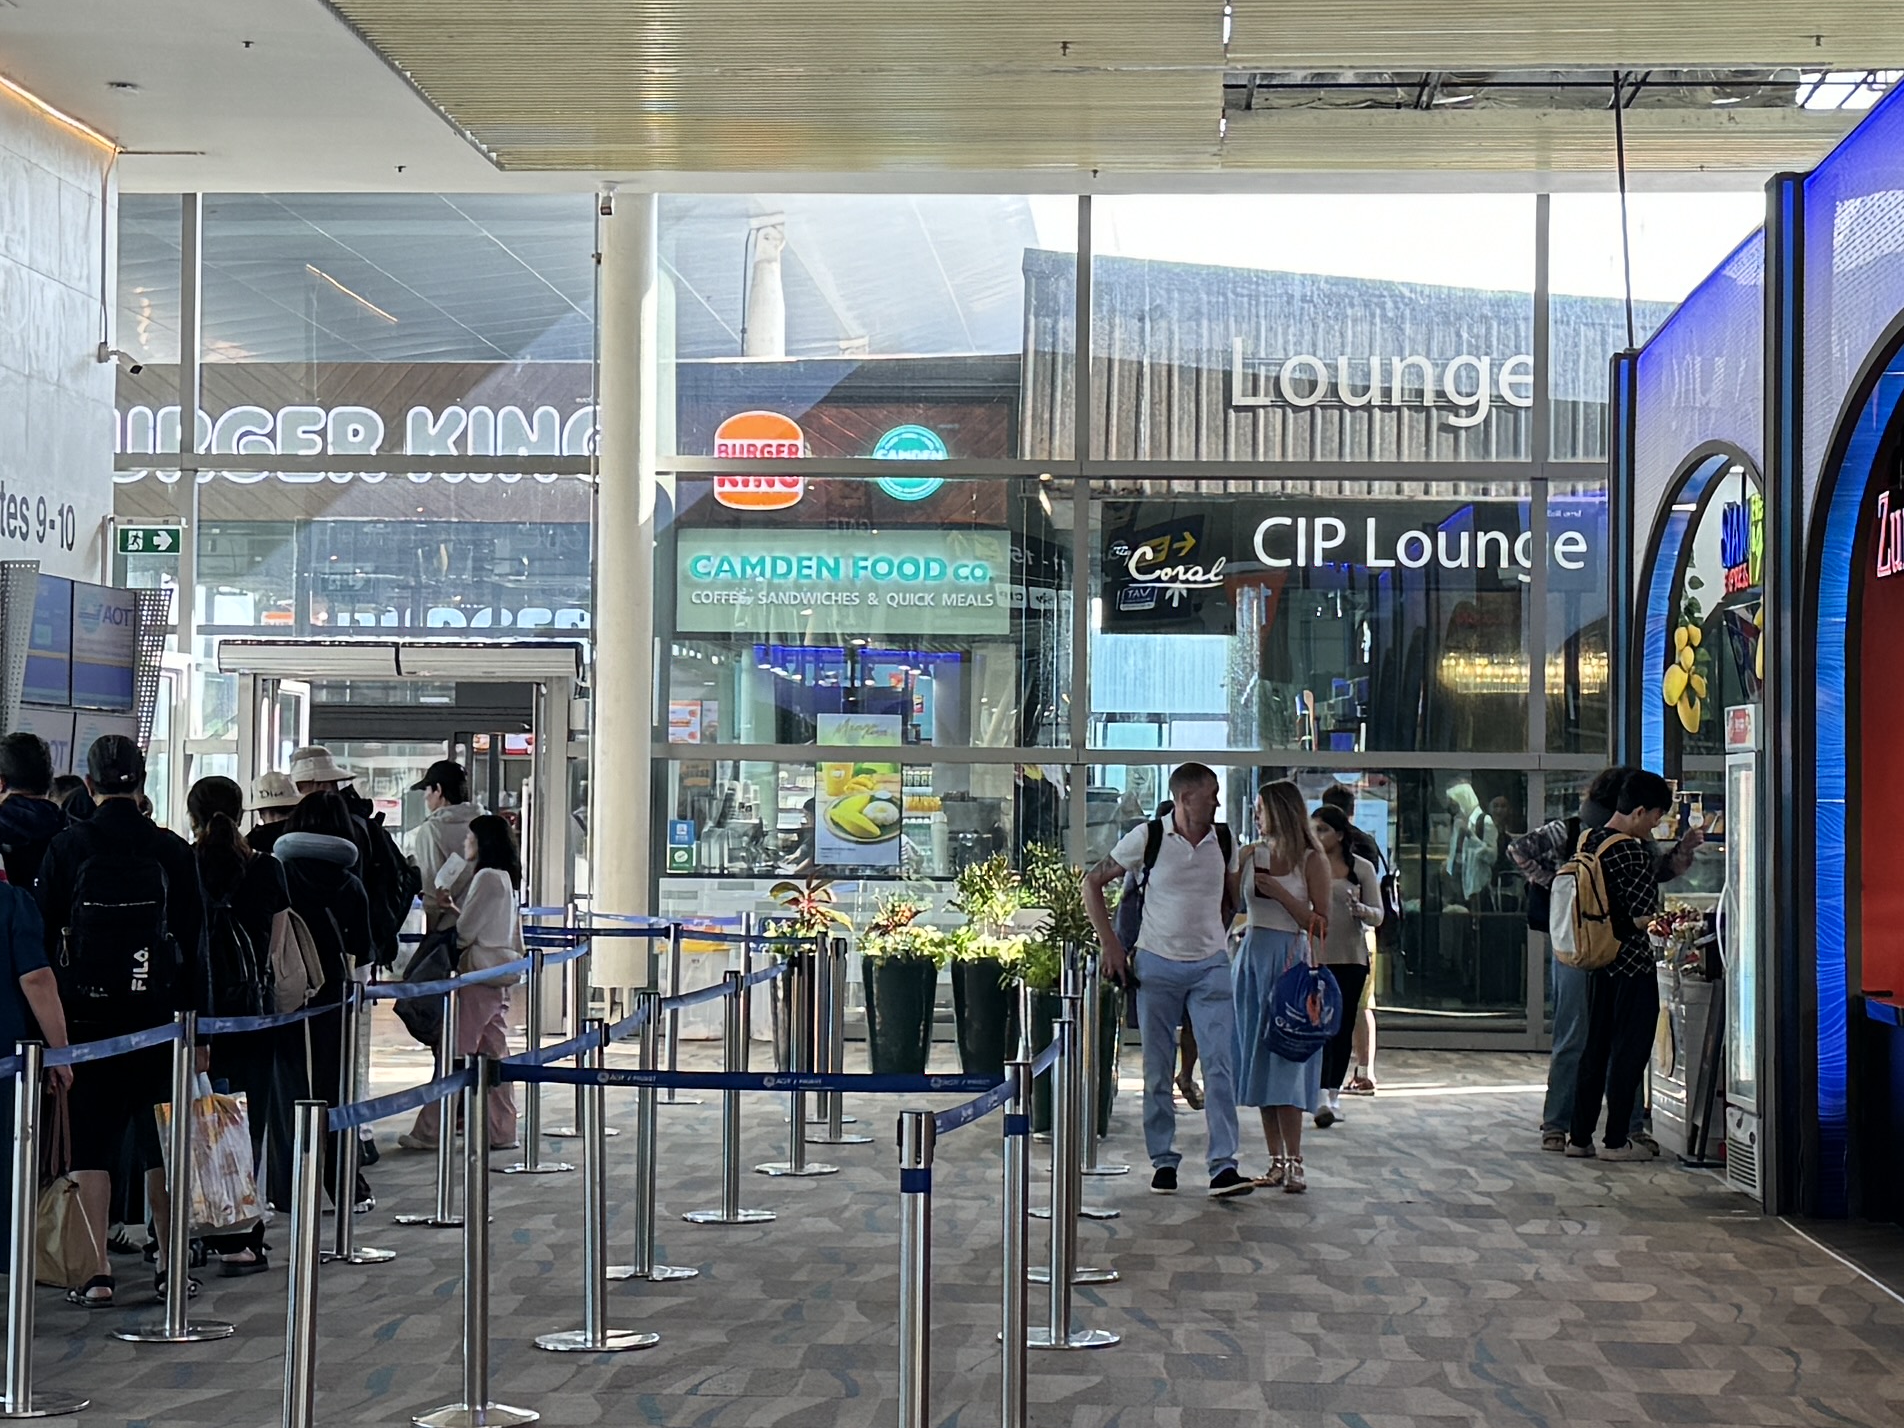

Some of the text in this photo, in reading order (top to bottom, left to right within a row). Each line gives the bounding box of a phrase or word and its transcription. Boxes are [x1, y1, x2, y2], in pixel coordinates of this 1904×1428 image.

[1231, 336, 1534, 428] Lounge
[113, 405, 387, 483] URGER
[1254, 516, 1346, 569] CIP
[690, 555, 840, 582] CAMDEN
[851, 555, 947, 582] FOOD
[1128, 545, 1227, 582] Coral
[102, 604, 134, 627] AOT
[757, 592, 860, 605] SANDWICHES
[867, 593, 879, 605] &
[887, 593, 935, 607] QUICK
[942, 593, 994, 607] MEALS
